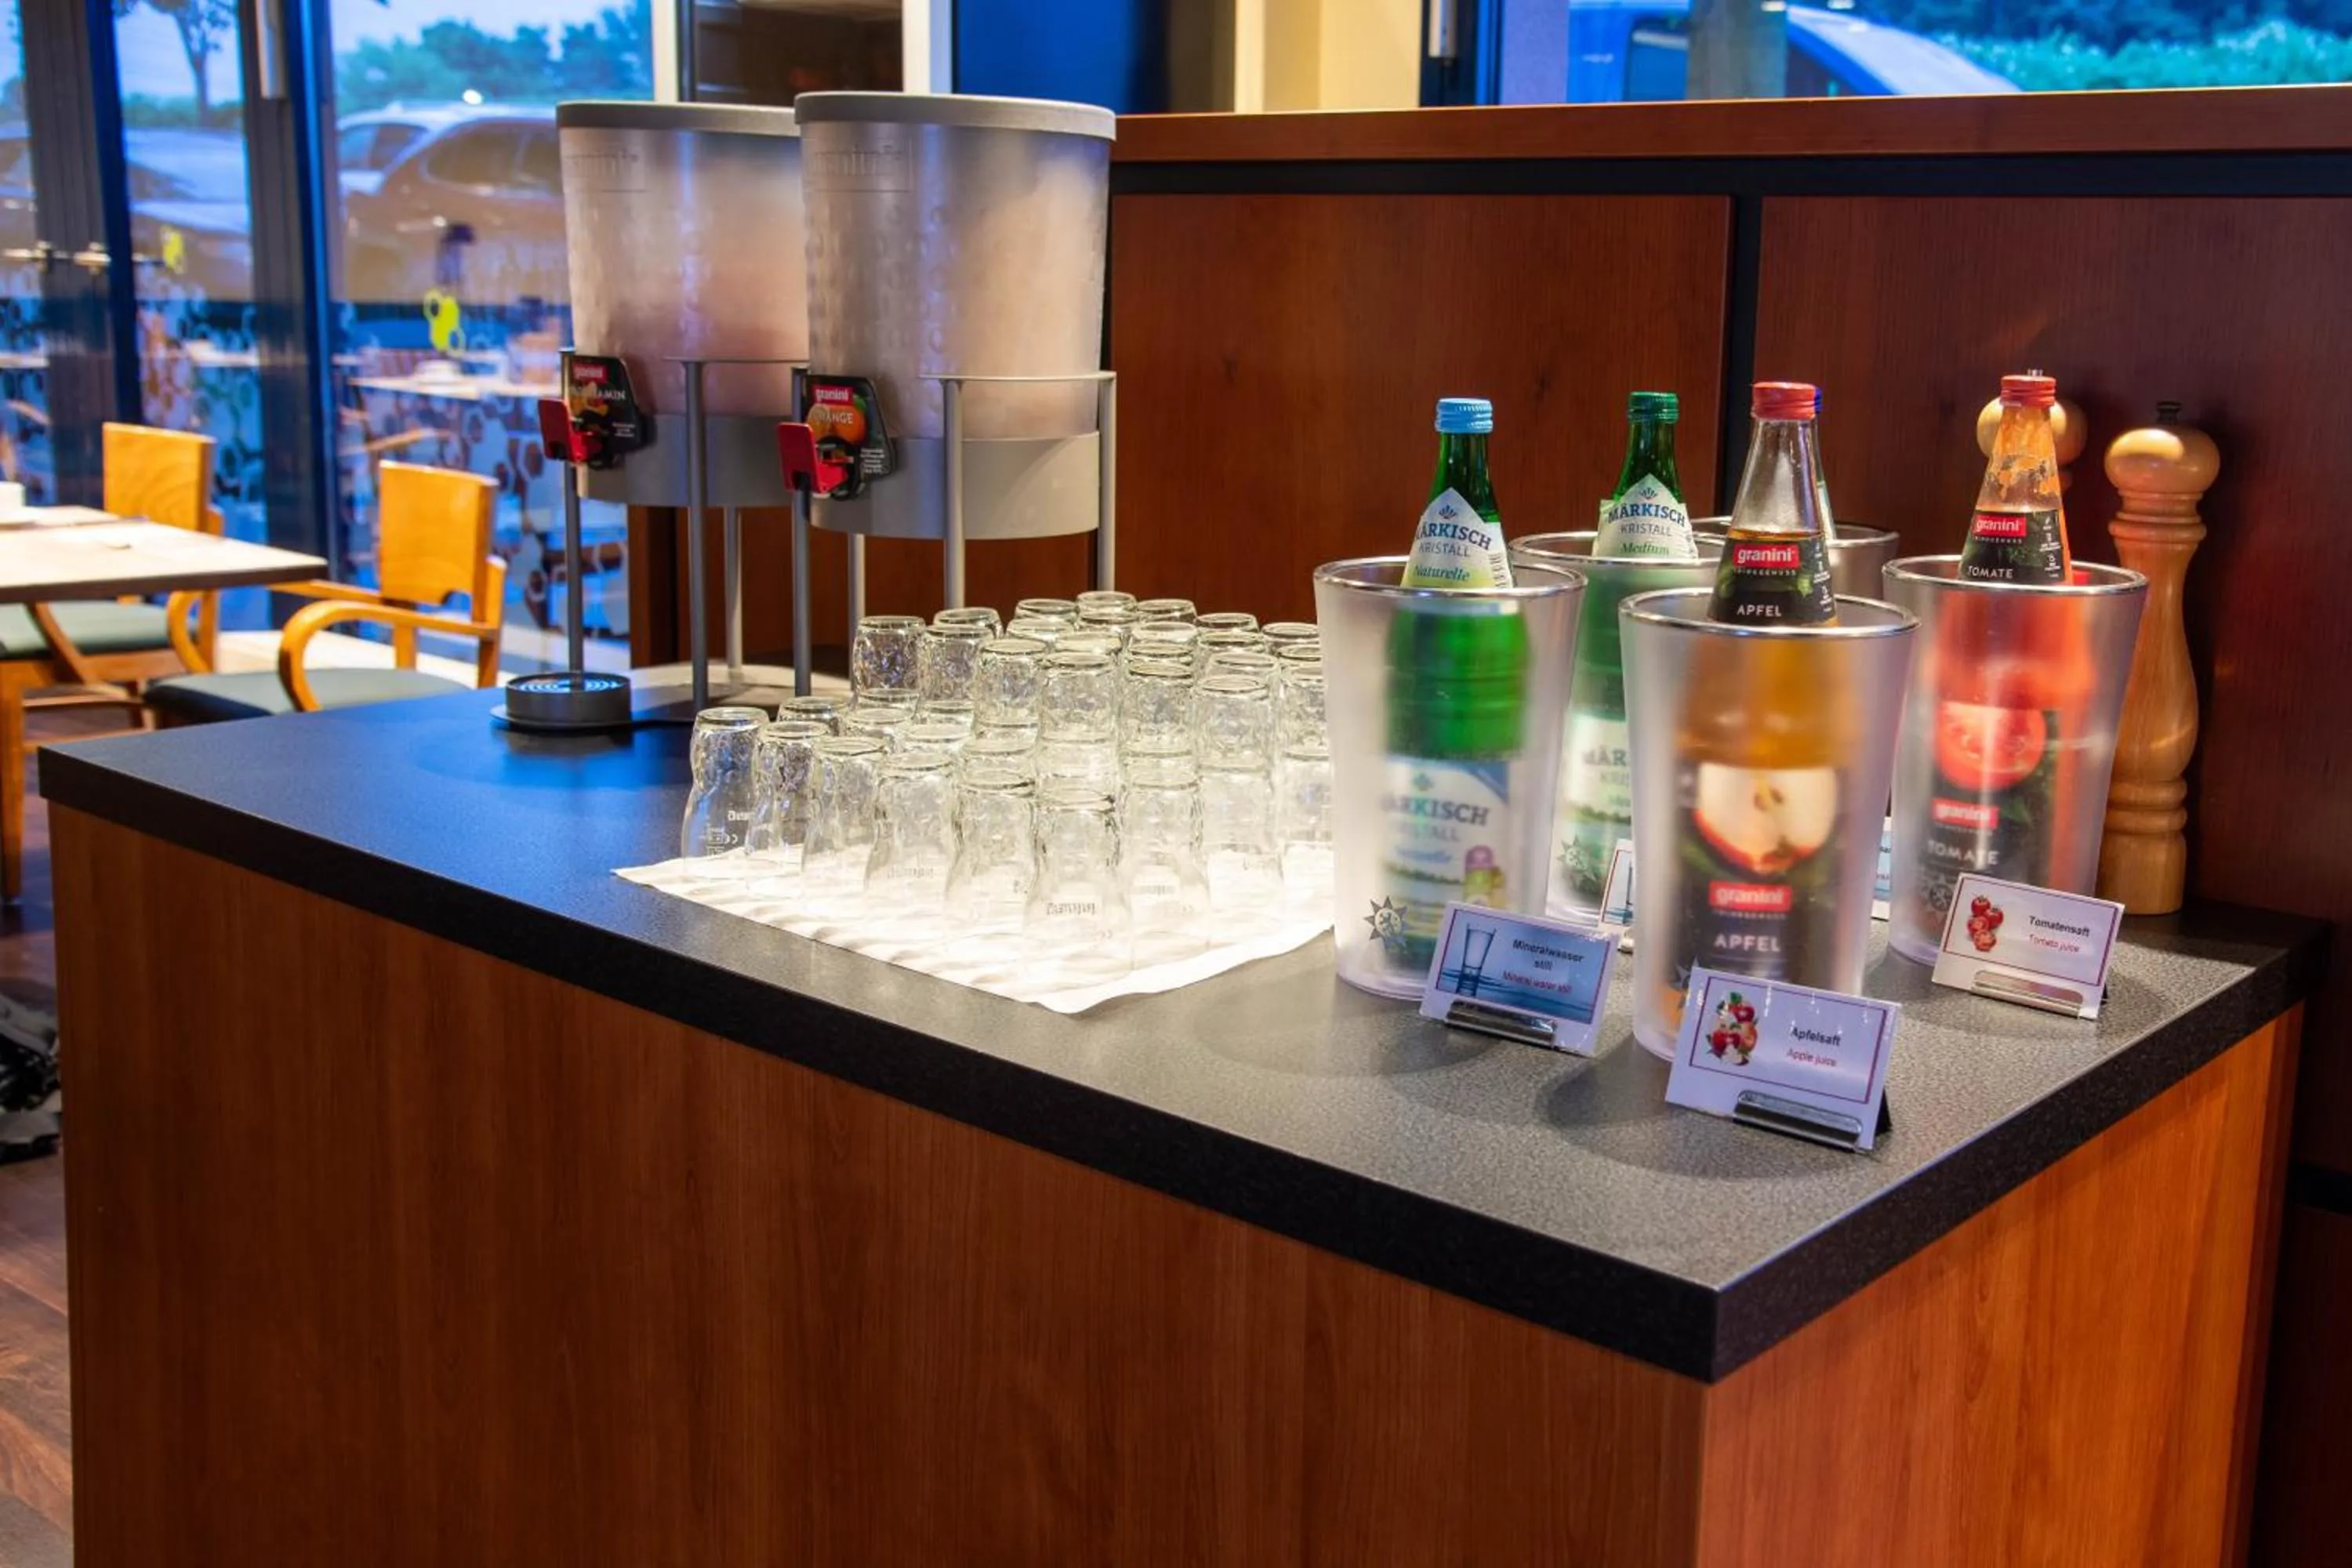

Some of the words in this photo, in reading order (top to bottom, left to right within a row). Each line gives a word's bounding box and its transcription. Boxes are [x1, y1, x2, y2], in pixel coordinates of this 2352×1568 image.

[1607, 503, 1685, 528] MÄRKISCH
[1620, 523, 1672, 536] KRISTALL
[1976, 518, 2020, 532] granini
[1621, 542, 1670, 555] Medium
[1737, 548, 1792, 564] granini
[1414, 564, 1470, 582] Naturelle
[1967, 564, 2013, 579] TOMATE
[1737, 604, 1782, 617] APFEL
[2029, 915, 2089, 938] Tomatensaft
[1715, 932, 1781, 953] APFEL
[2029, 934, 2059, 948] Tomato
[1512, 939, 1584, 964] Mineralwasser
[1791, 1026, 1842, 1047] Apfelsaft
[1787, 1047, 1813, 1062] Apple
